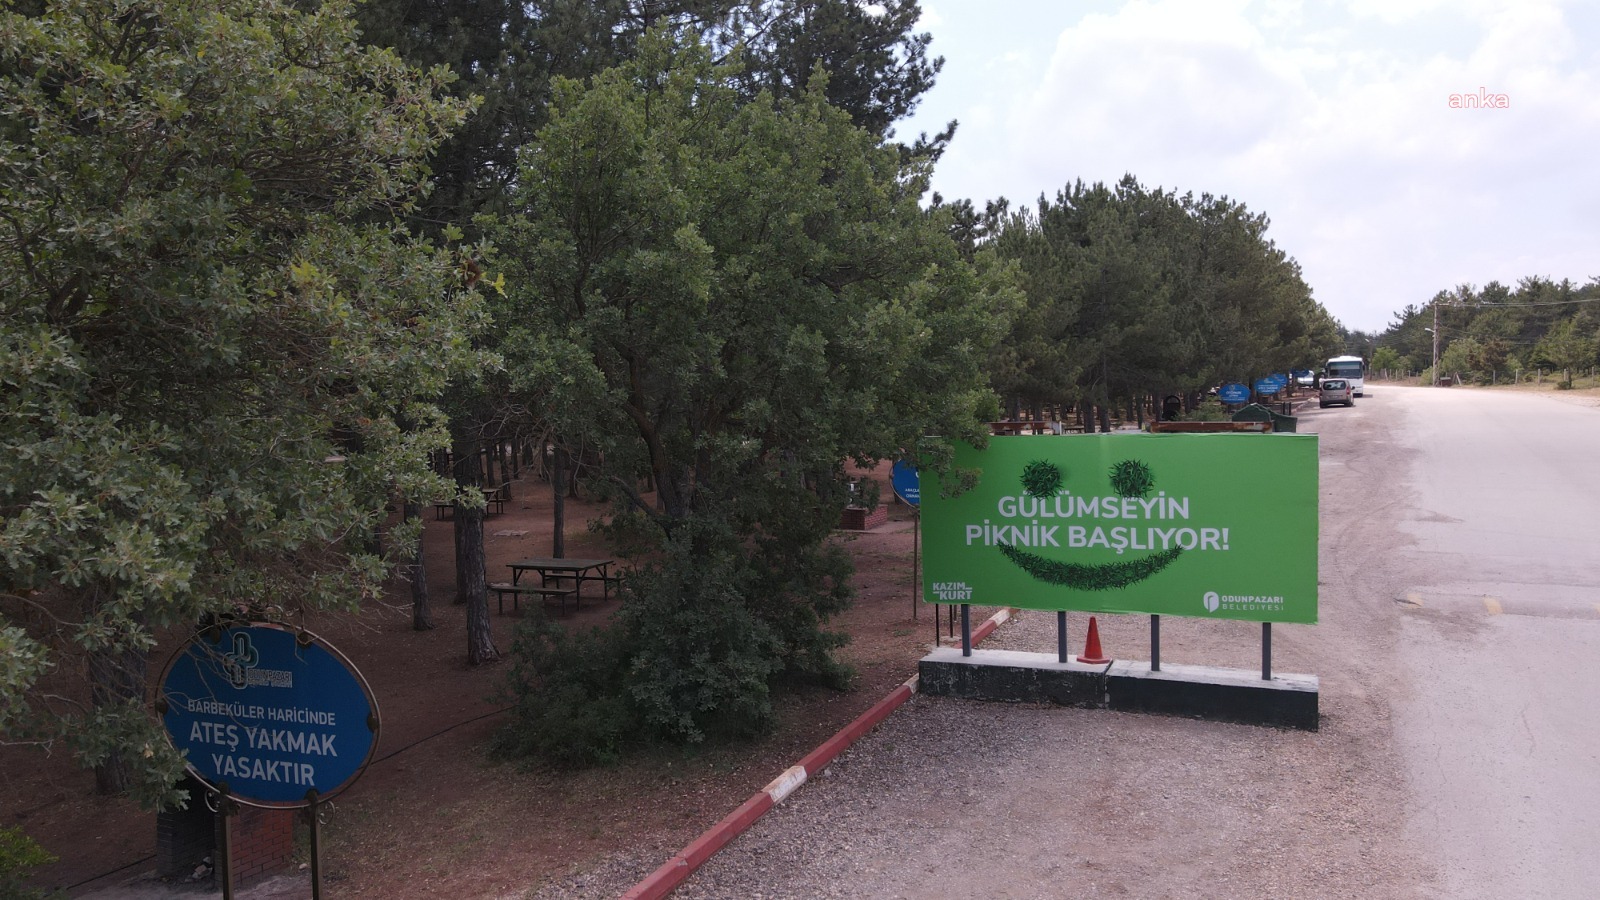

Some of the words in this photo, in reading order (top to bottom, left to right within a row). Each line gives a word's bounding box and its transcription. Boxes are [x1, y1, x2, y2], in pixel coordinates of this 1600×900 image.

[998, 490, 1189, 519] GÜLÜMSEYİN
[966, 519, 1060, 548] PİKNİK
[1068, 526, 1230, 554] BAŞLIYOR!
[932, 582, 966, 590] KAZIM
[940, 590, 972, 600] KURT
[1221, 595, 1284, 603] ODUNPAZARI
[1222, 603, 1284, 611] BELEDİYESİ
[188, 699, 264, 719] BARBEKÜLER
[268, 706, 336, 726] HARİCİNDE
[190, 721, 239, 752] ATEŞ
[245, 726, 338, 757] YAKMAK
[211, 753, 315, 786] YASAKTIR
